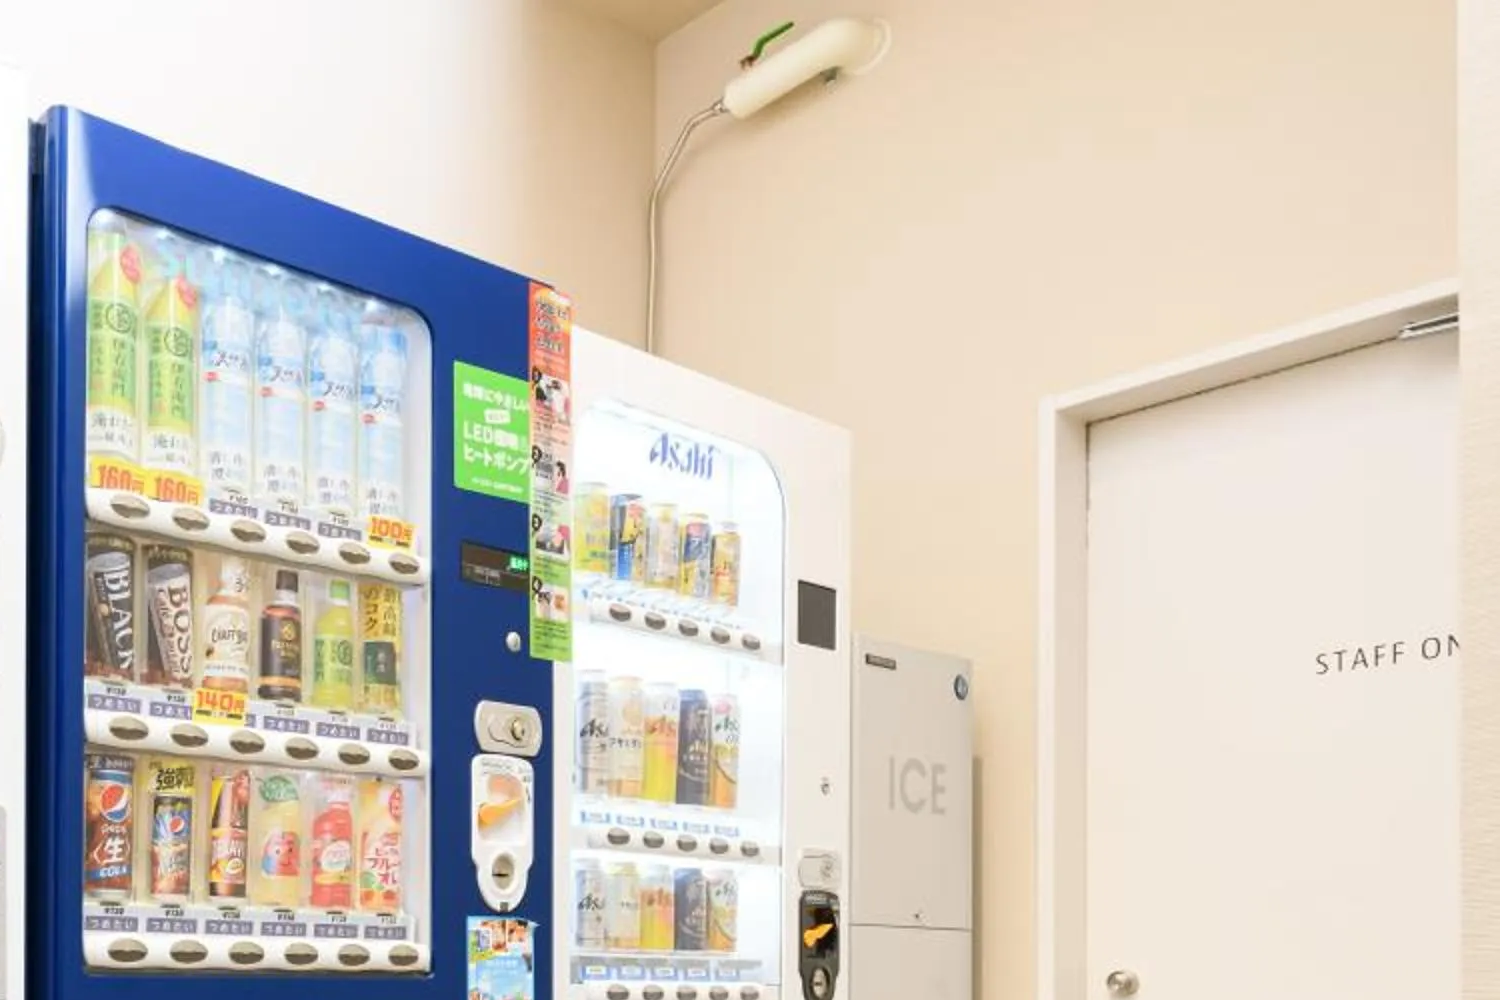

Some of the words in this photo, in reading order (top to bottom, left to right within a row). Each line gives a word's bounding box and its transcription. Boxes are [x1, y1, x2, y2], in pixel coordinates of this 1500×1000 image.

[98, 464, 145, 495] 160円
[649, 432, 714, 480] Asahi
[154, 477, 199, 506] 160円
[104, 562, 134, 669] BLACK
[167, 585, 193, 674] BOSS
[1315, 641, 1405, 675] STAFF
[888, 756, 948, 815] ICE
